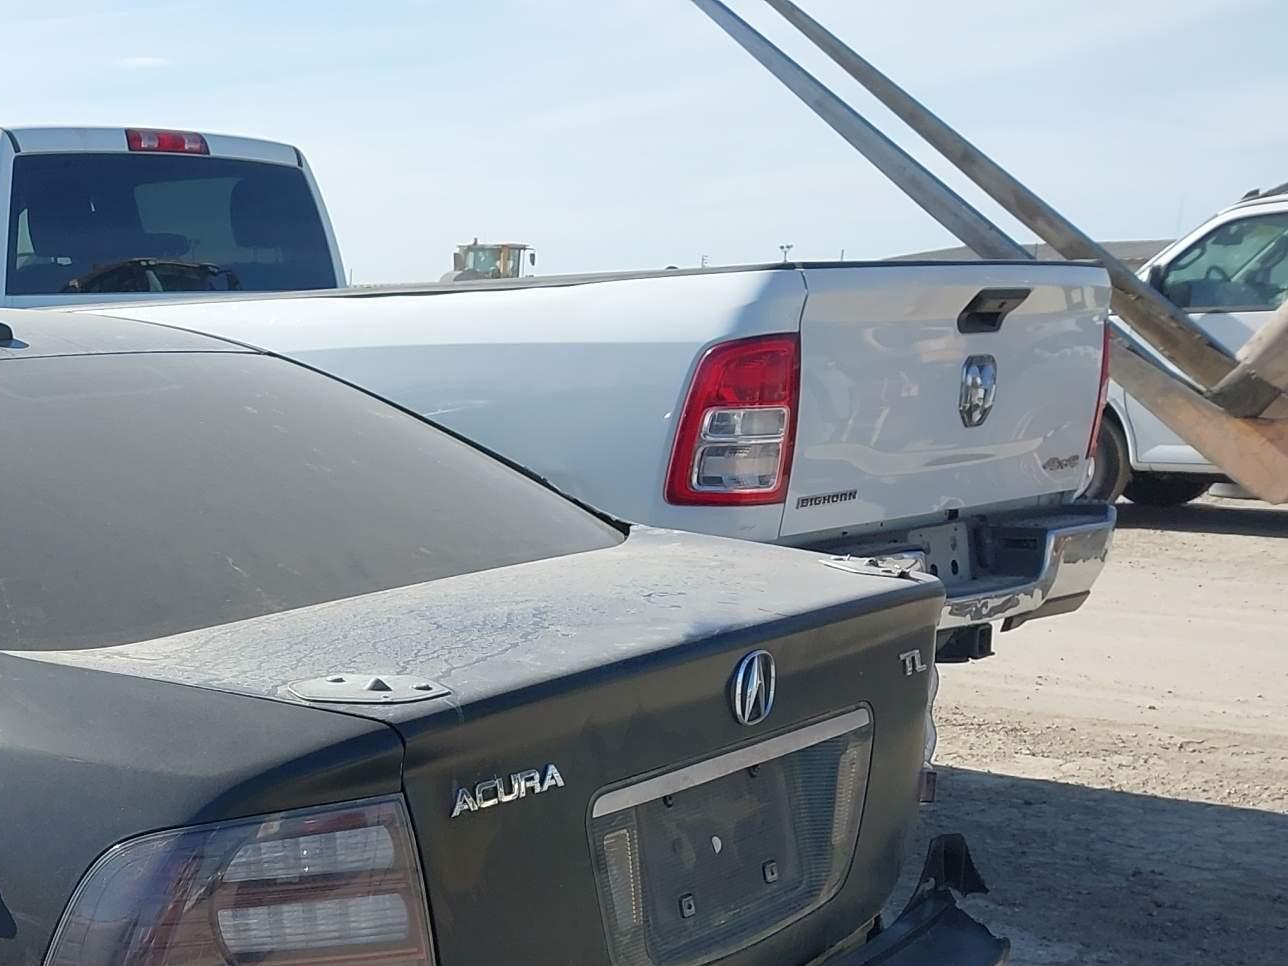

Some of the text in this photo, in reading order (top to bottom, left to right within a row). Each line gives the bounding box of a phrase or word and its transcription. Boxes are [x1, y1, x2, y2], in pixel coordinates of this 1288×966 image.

[796, 489, 857, 510] BIGHORN
[899, 649, 927, 676] TL
[451, 764, 565, 818] ACURA
